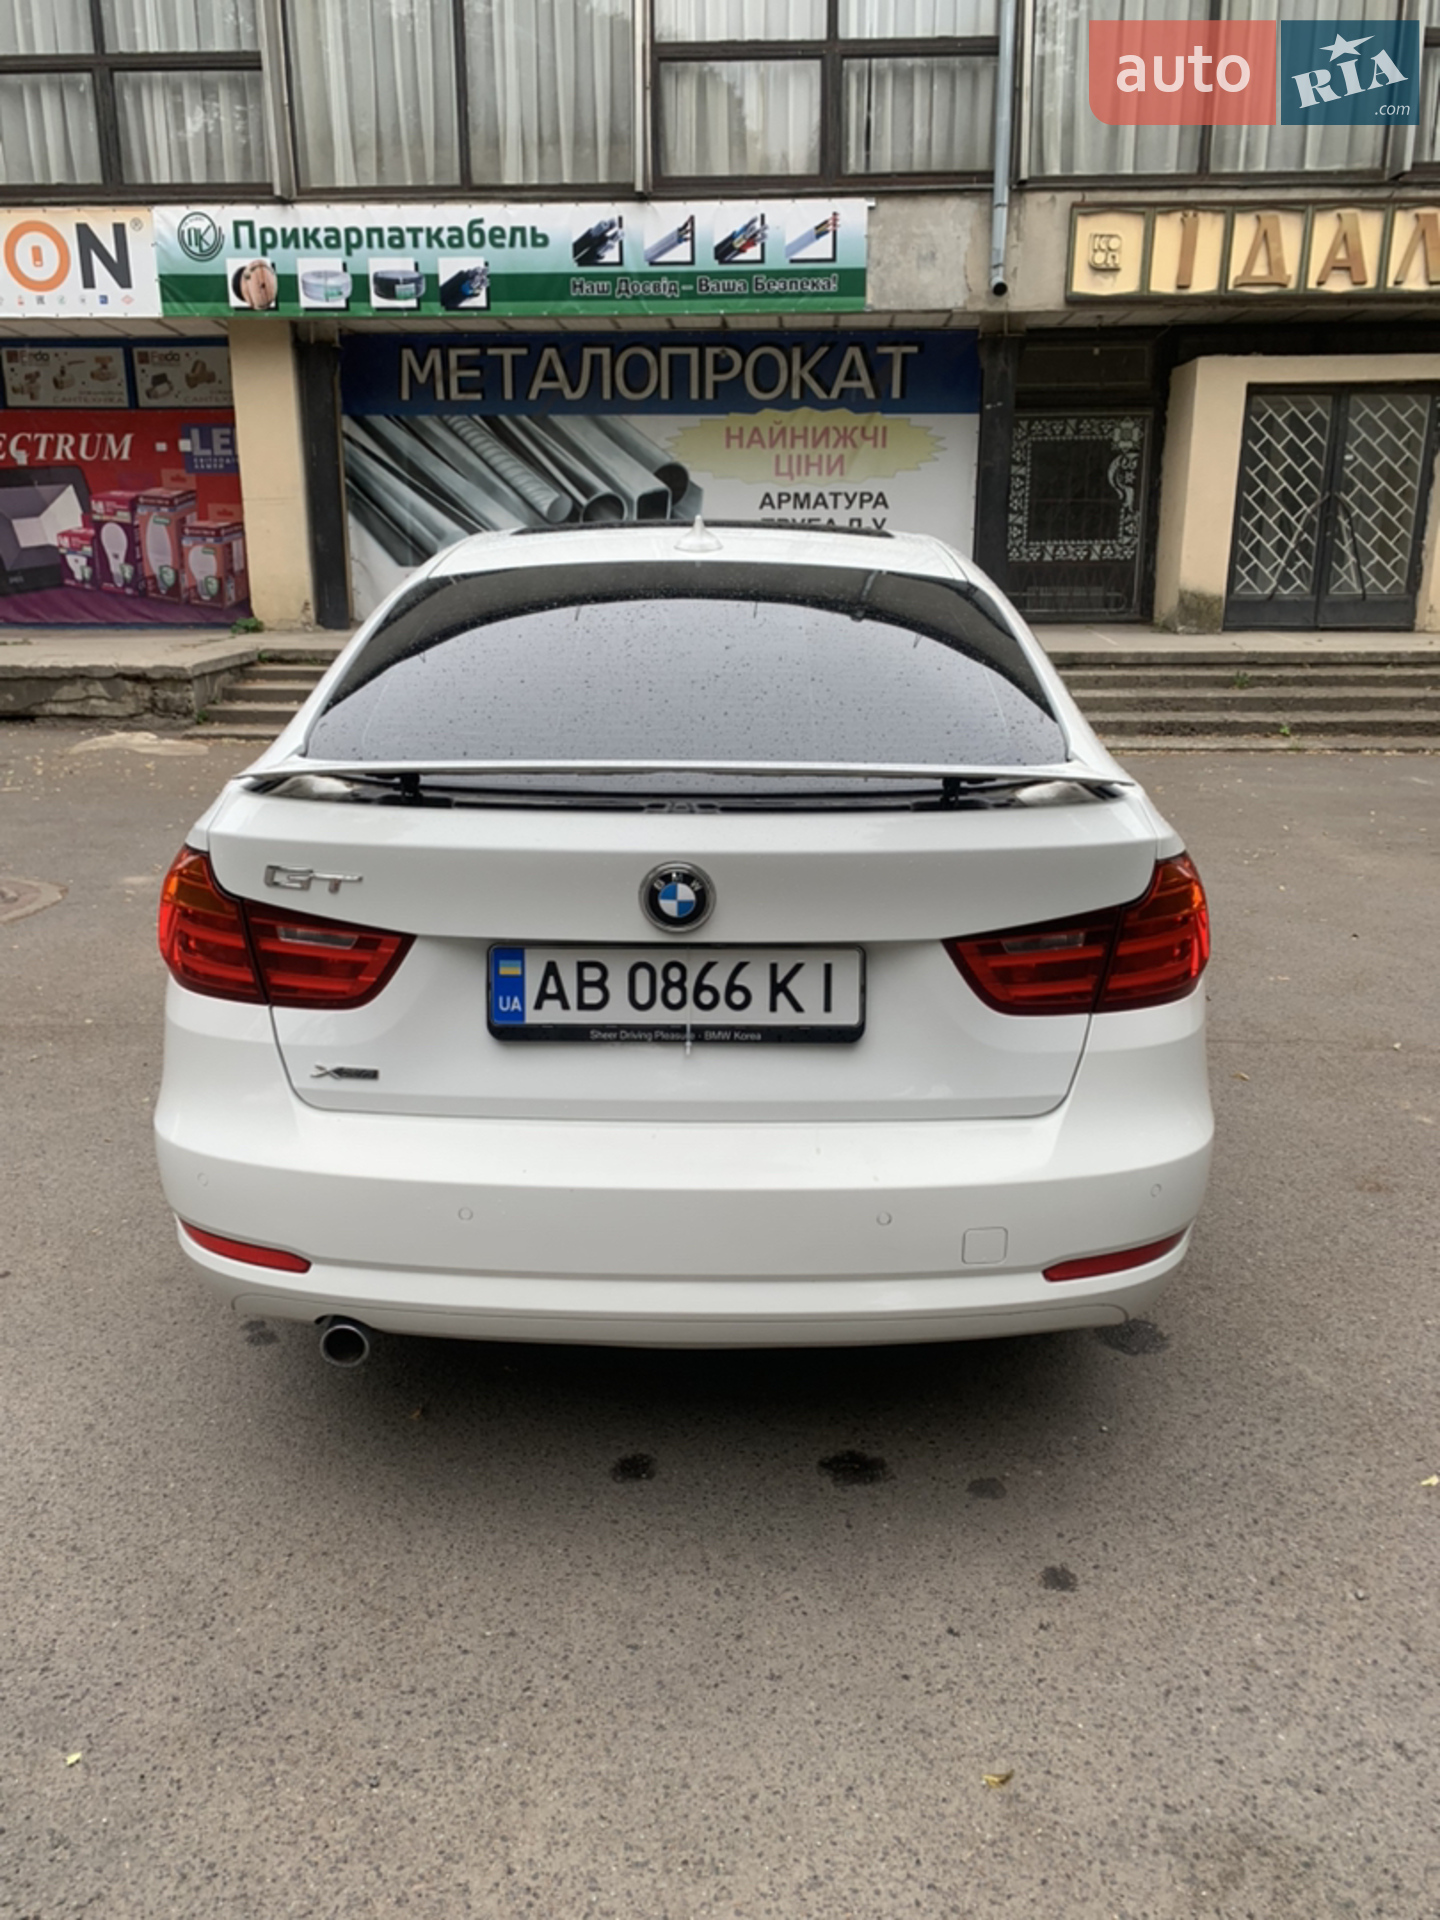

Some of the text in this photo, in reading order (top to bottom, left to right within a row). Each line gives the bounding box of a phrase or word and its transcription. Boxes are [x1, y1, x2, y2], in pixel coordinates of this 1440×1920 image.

[232, 218, 550, 256] Прикарпаткабель
[570, 278, 611, 296] Наш
[615, 278, 679, 297] Досвід
[696, 276, 748, 294] Ваша
[752, 274, 838, 293] Безпека!
[401, 346, 919, 401] МЕТАЛОПРОКАТ
[724, 420, 888, 450] НАЙНИЖЧІ
[774, 453, 845, 482] ЦІНИ
[759, 491, 889, 511] АРМАТУРА
[653, 872, 702, 892] BMW
[533, 960, 833, 1013] AB 0866 KI
[499, 996, 522, 1012] UA
[589, 1030, 762, 1042] Sheer Driving Pleasue BMW Korea
